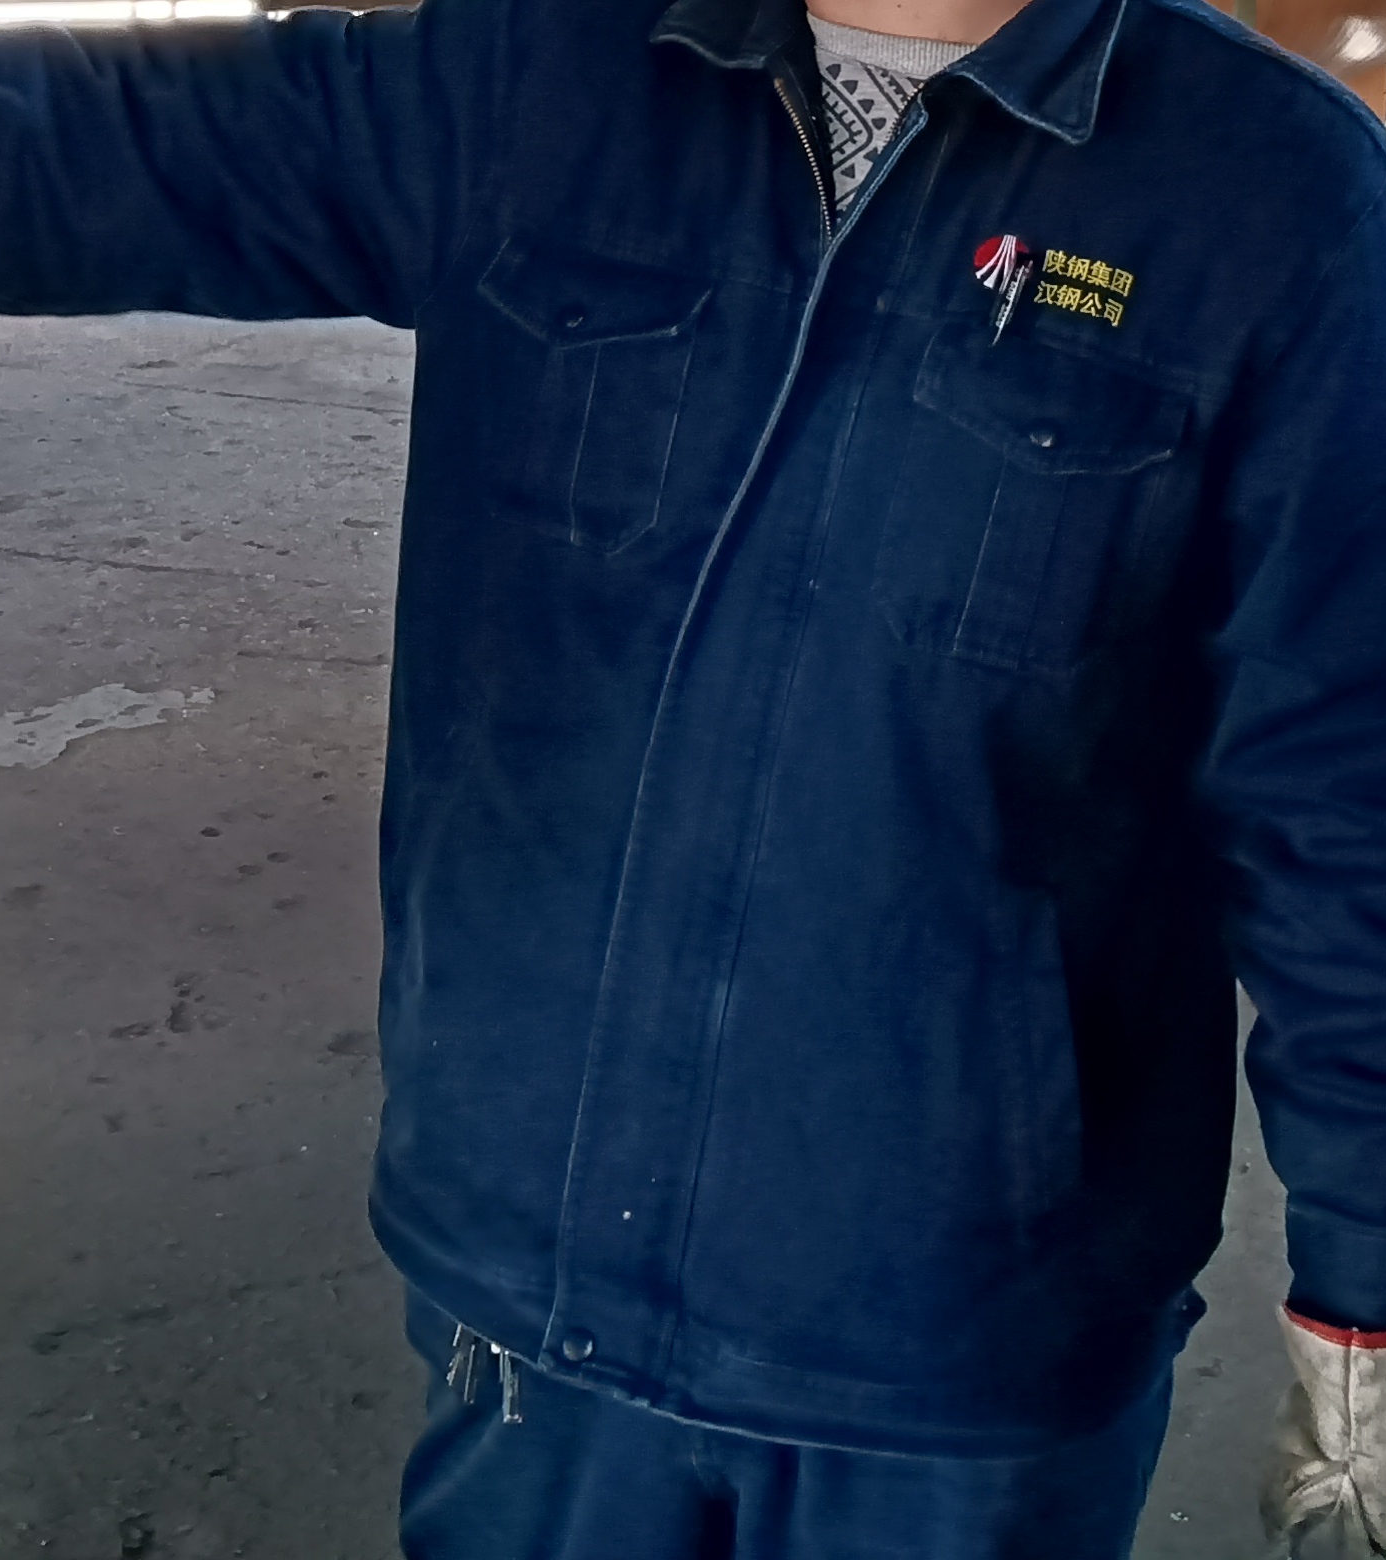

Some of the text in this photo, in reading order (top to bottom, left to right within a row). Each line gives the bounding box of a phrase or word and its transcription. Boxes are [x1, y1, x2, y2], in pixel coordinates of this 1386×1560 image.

[1043, 249, 1135, 297] 陕钢集团
[1033, 281, 1125, 327] 汉钢公司
